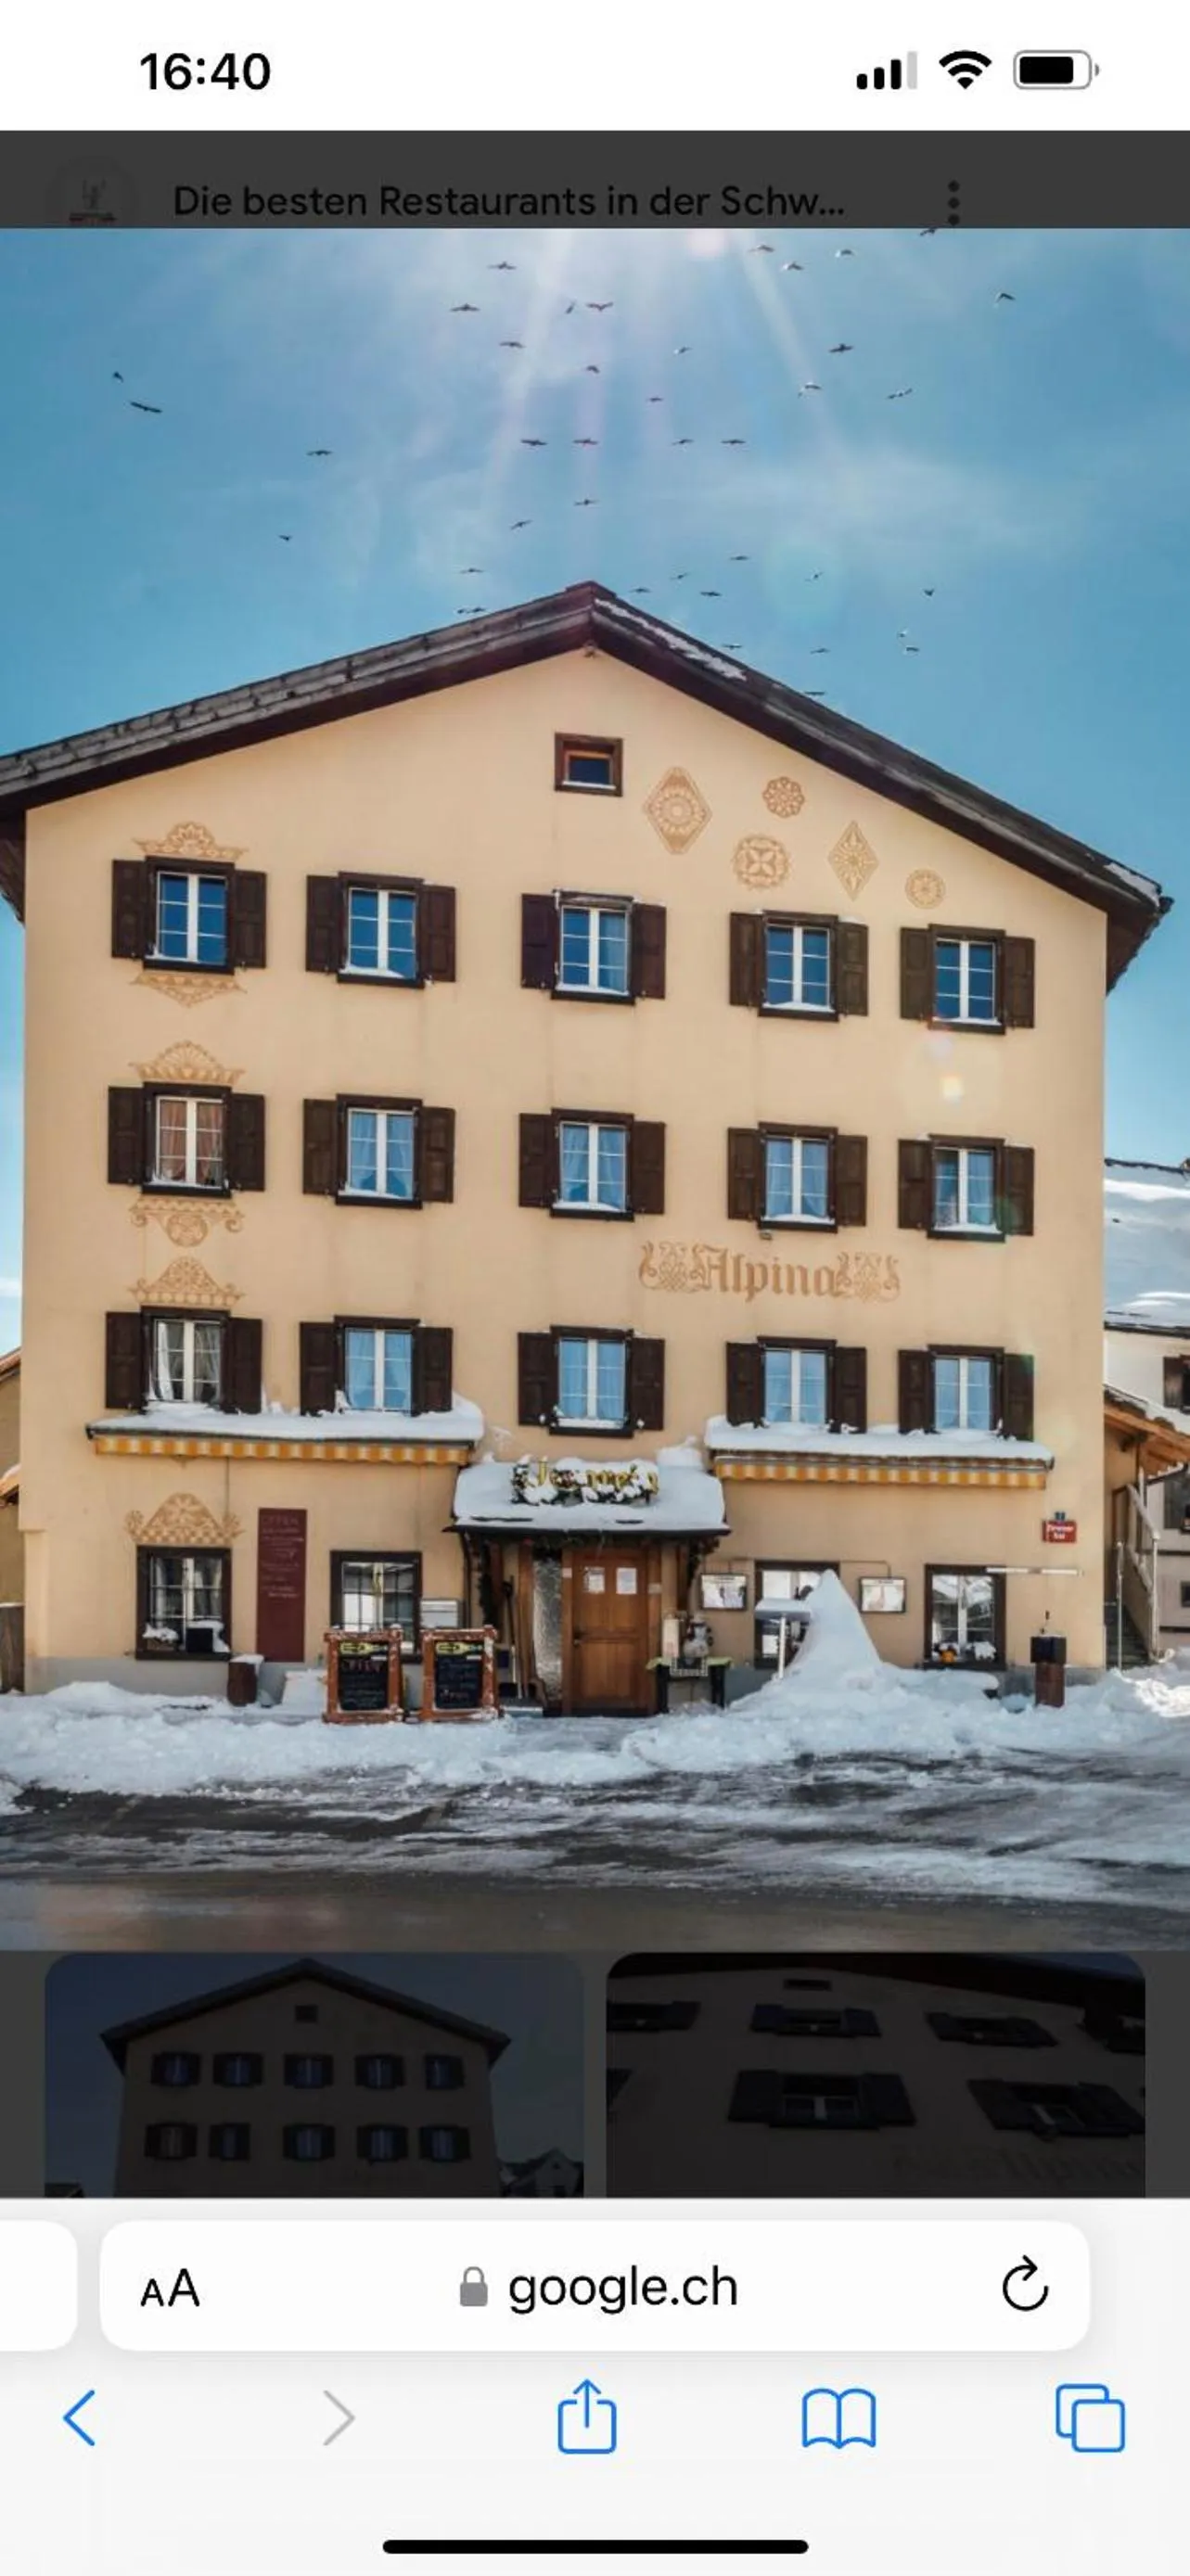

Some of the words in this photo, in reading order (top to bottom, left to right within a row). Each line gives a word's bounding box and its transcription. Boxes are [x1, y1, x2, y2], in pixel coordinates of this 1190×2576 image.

[140, 52, 271, 91] 16:40
[174, 185, 232, 216] Die
[243, 185, 367, 216] besten
[380, 185, 596, 216] Restaurants
[608, 185, 638, 216] in
[649, 185, 711, 216] der
[690, 1243, 844, 1302] Alpina
[509, 2264, 737, 2315] google.ch
